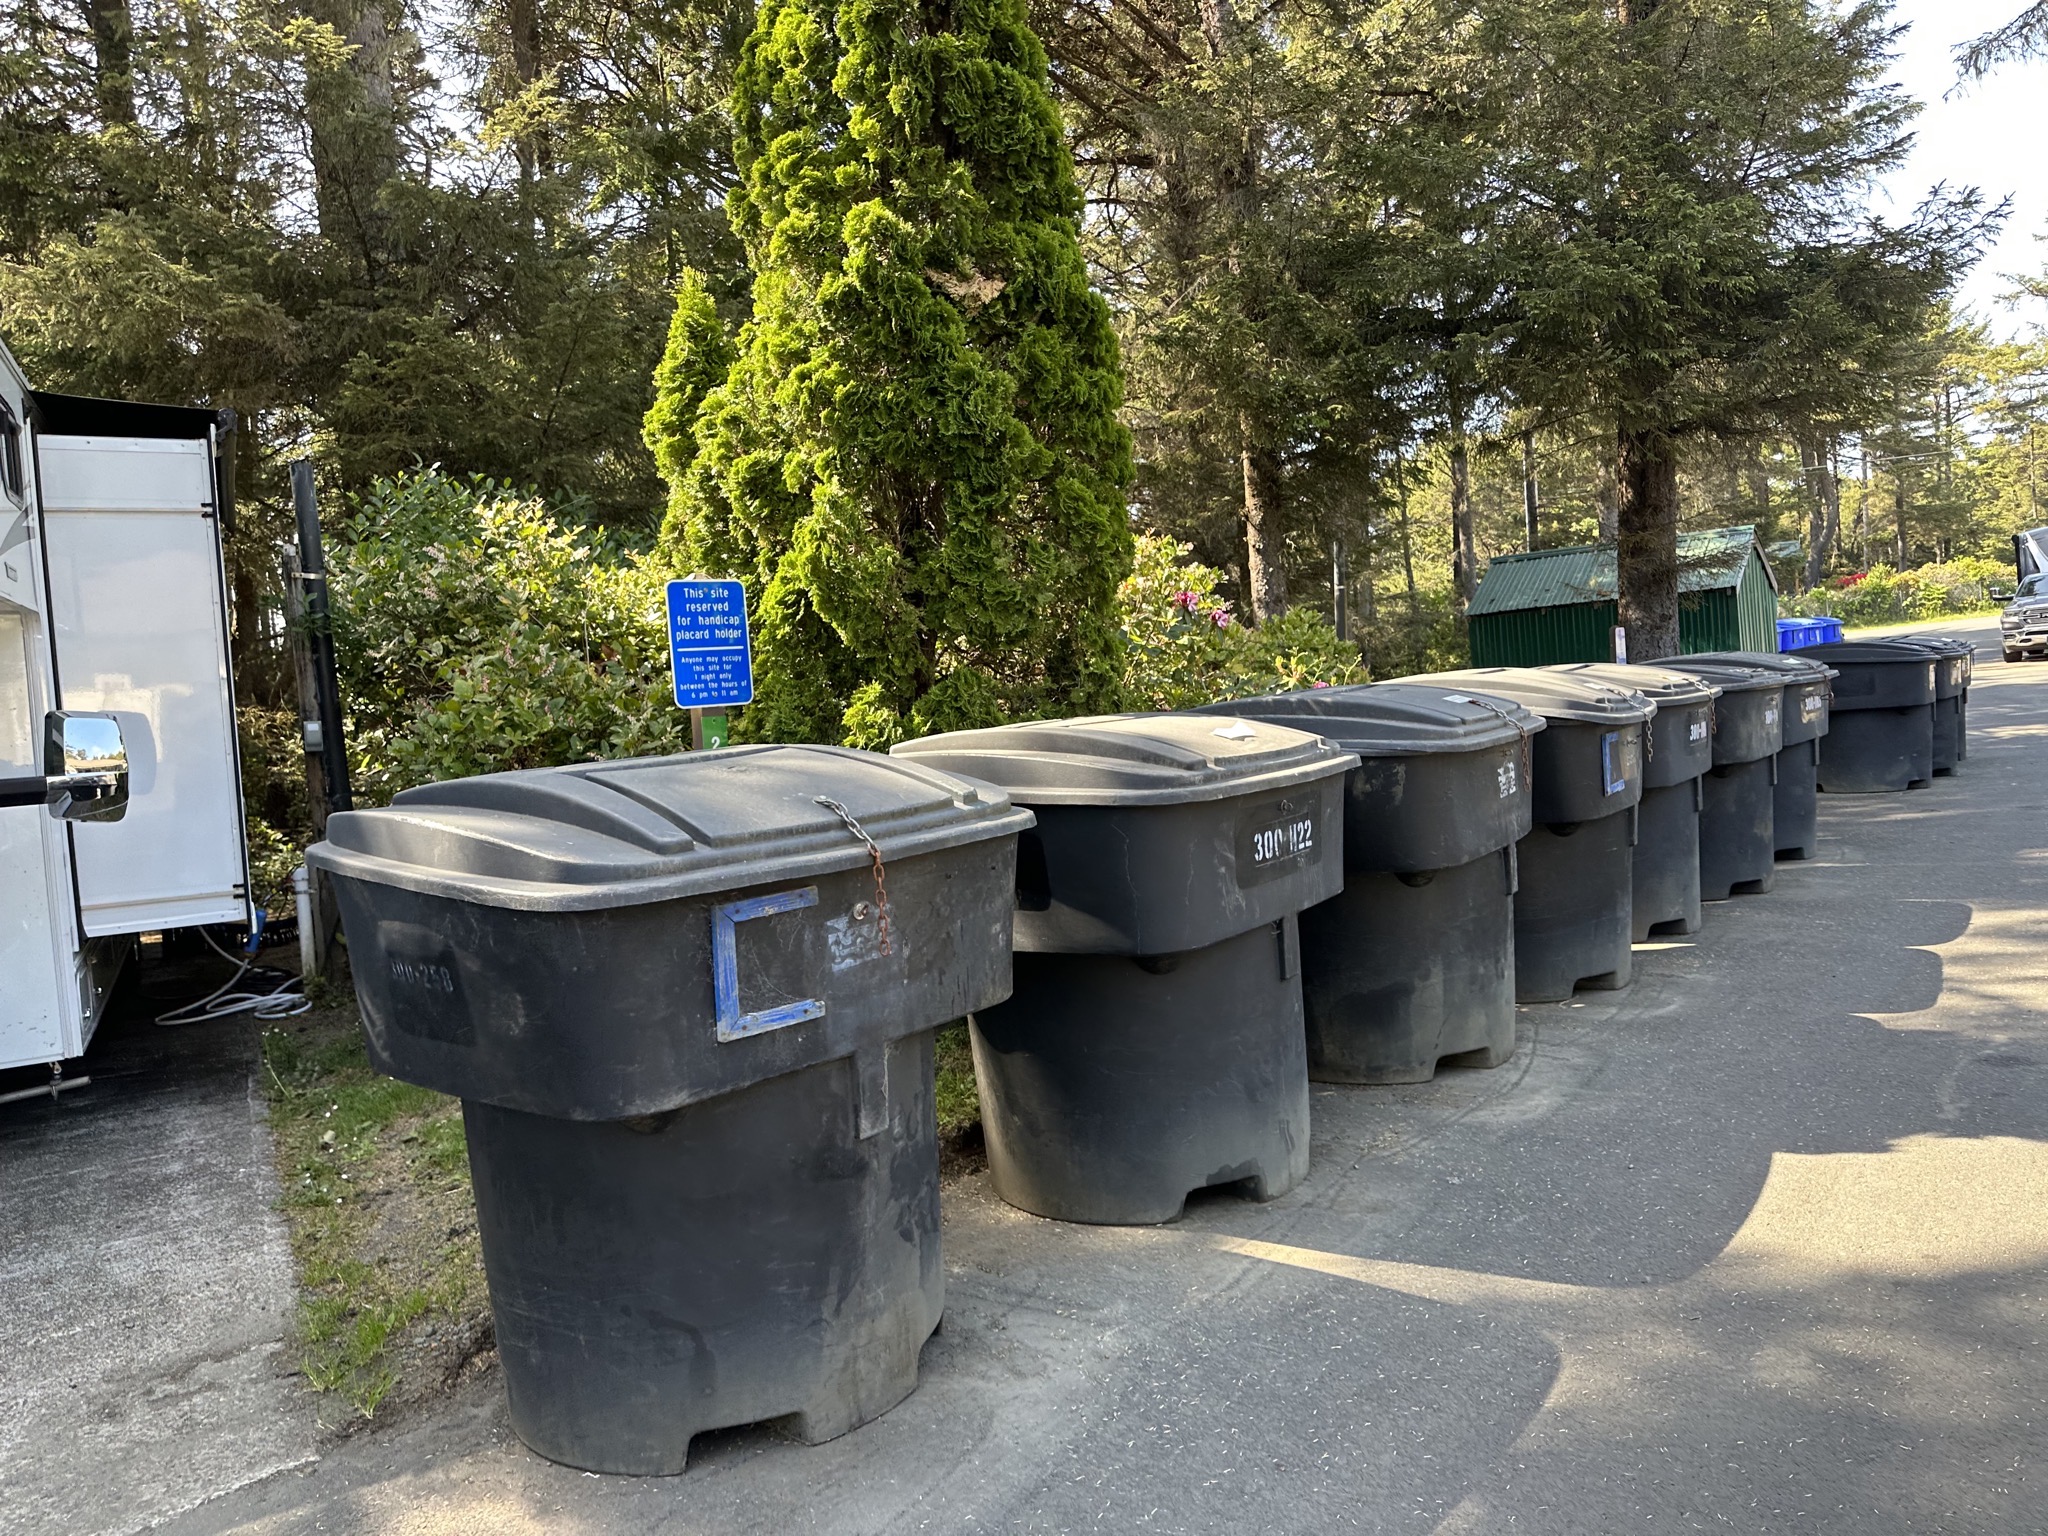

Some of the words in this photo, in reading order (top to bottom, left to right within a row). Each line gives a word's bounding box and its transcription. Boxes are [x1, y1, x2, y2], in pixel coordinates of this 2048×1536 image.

[683, 587, 704, 599] This
[710, 587, 729, 598] site
[686, 601, 729, 612] reserved
[677, 615, 691, 626] for
[698, 614, 740, 627] handicap
[676, 628, 709, 643] placard
[715, 628, 742, 639] holder
[681, 656, 703, 664] Anyone
[706, 656, 719, 664] may
[701, 673, 716, 682] night
[719, 672, 732, 680] only
[711, 736, 720, 749] 2
